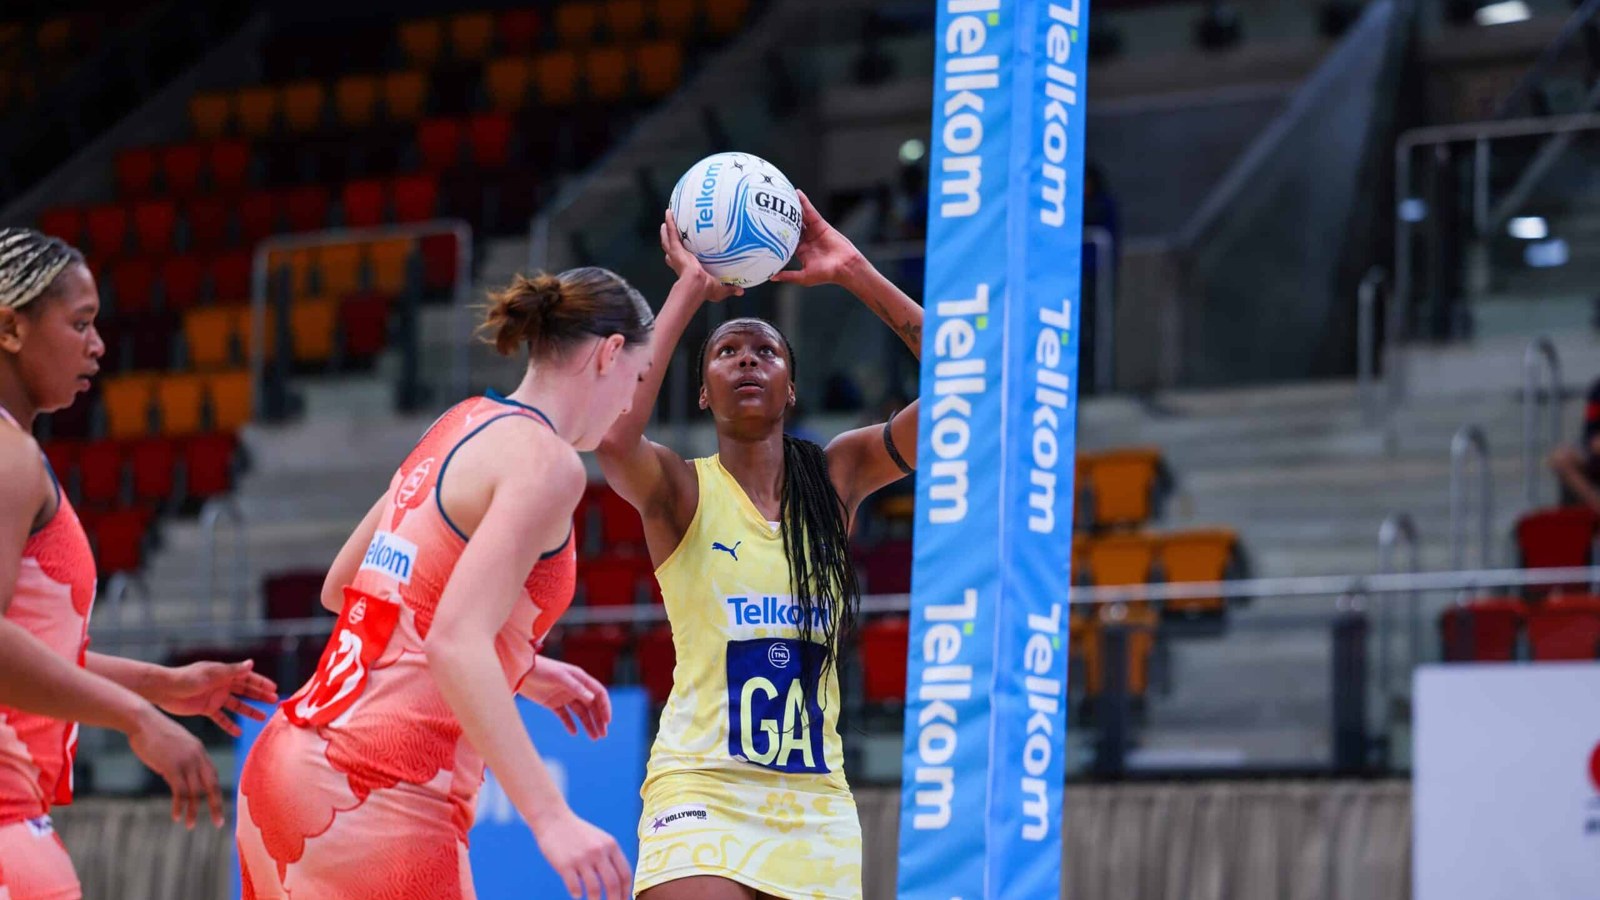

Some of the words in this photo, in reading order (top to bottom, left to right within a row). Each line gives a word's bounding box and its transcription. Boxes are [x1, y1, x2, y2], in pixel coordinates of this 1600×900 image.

[695, 161, 723, 234] Telkom
[1040, 0, 1080, 228] Telkom
[929, 283, 990, 524] Telkom
[1028, 299, 1071, 534] Telkom
[365, 534, 410, 578] elkom
[665, 810, 707, 824] HOLLYWOOD
[740, 676, 816, 768] GA
[913, 588, 978, 830] Telkom
[1021, 603, 1061, 841] Telkom
